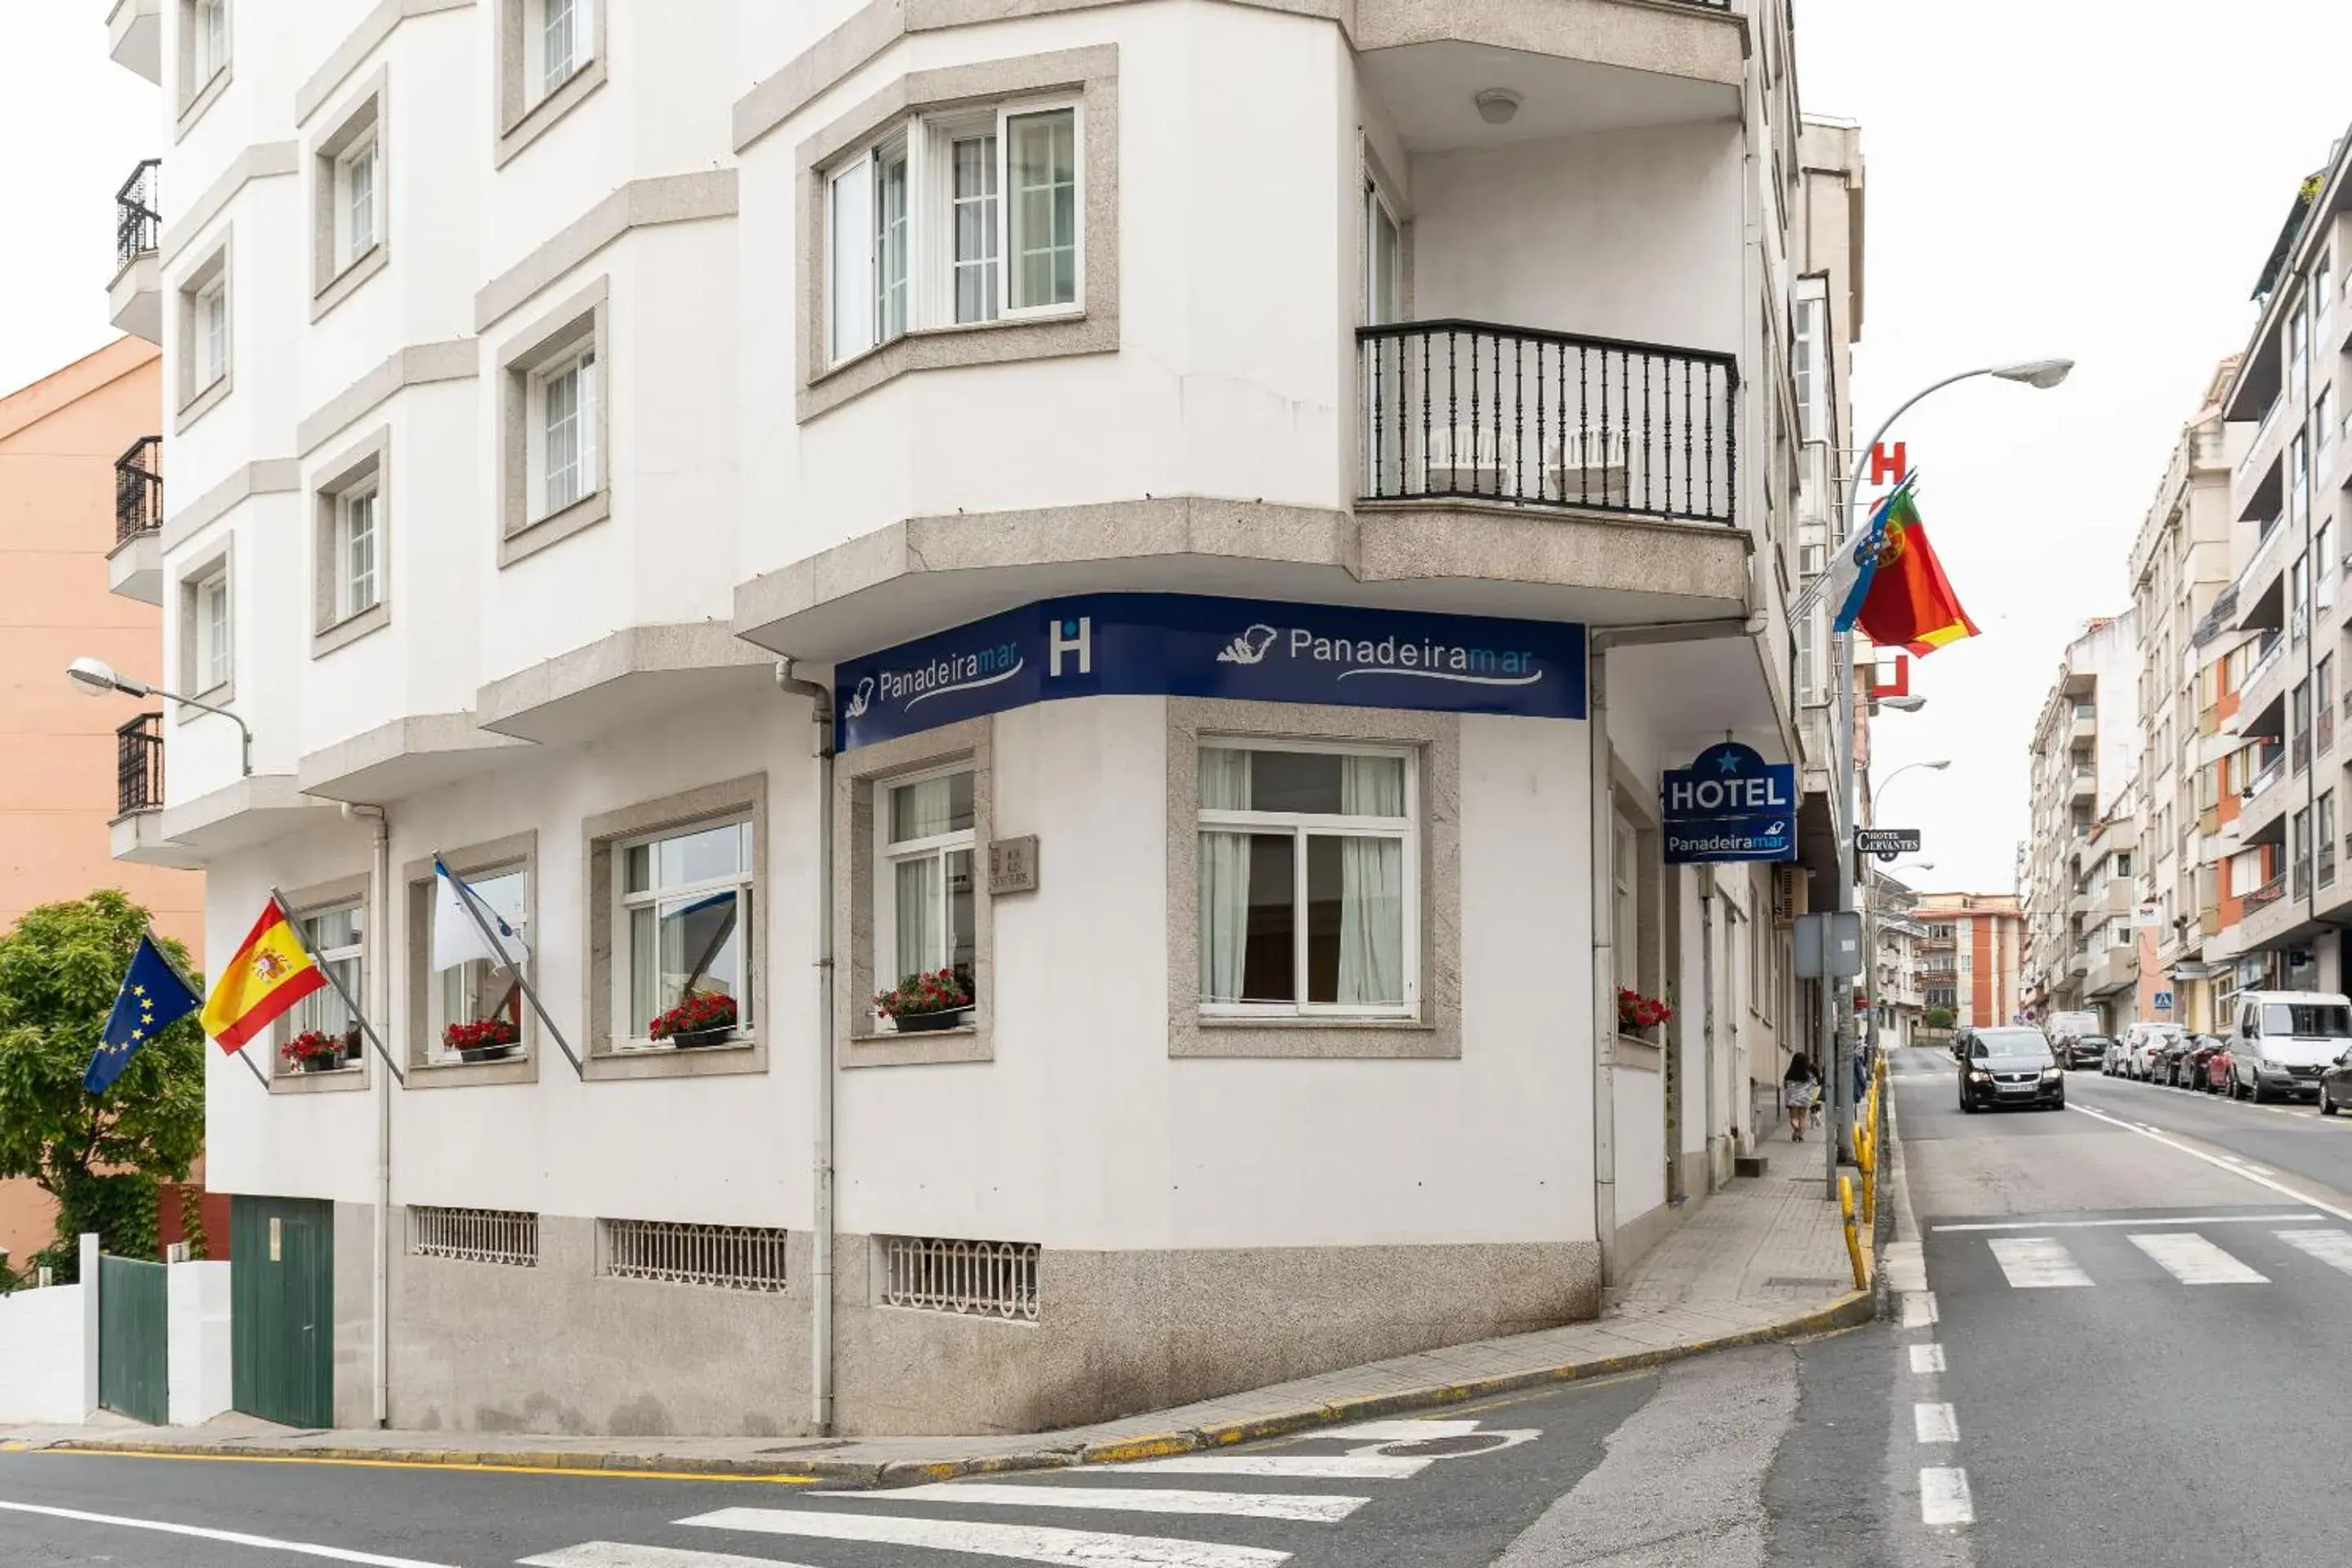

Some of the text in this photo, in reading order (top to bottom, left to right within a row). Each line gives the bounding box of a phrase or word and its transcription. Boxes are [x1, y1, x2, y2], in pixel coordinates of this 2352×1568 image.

[1049, 616, 1091, 677] H
[1290, 627, 1531, 674] Panadeiramar
[879, 640, 1017, 701] Panadeiramar
[1672, 777, 1787, 810] HOTEL
[1668, 834, 1787, 852] Panadeiramar
[1869, 831, 1900, 840] HOTEL
